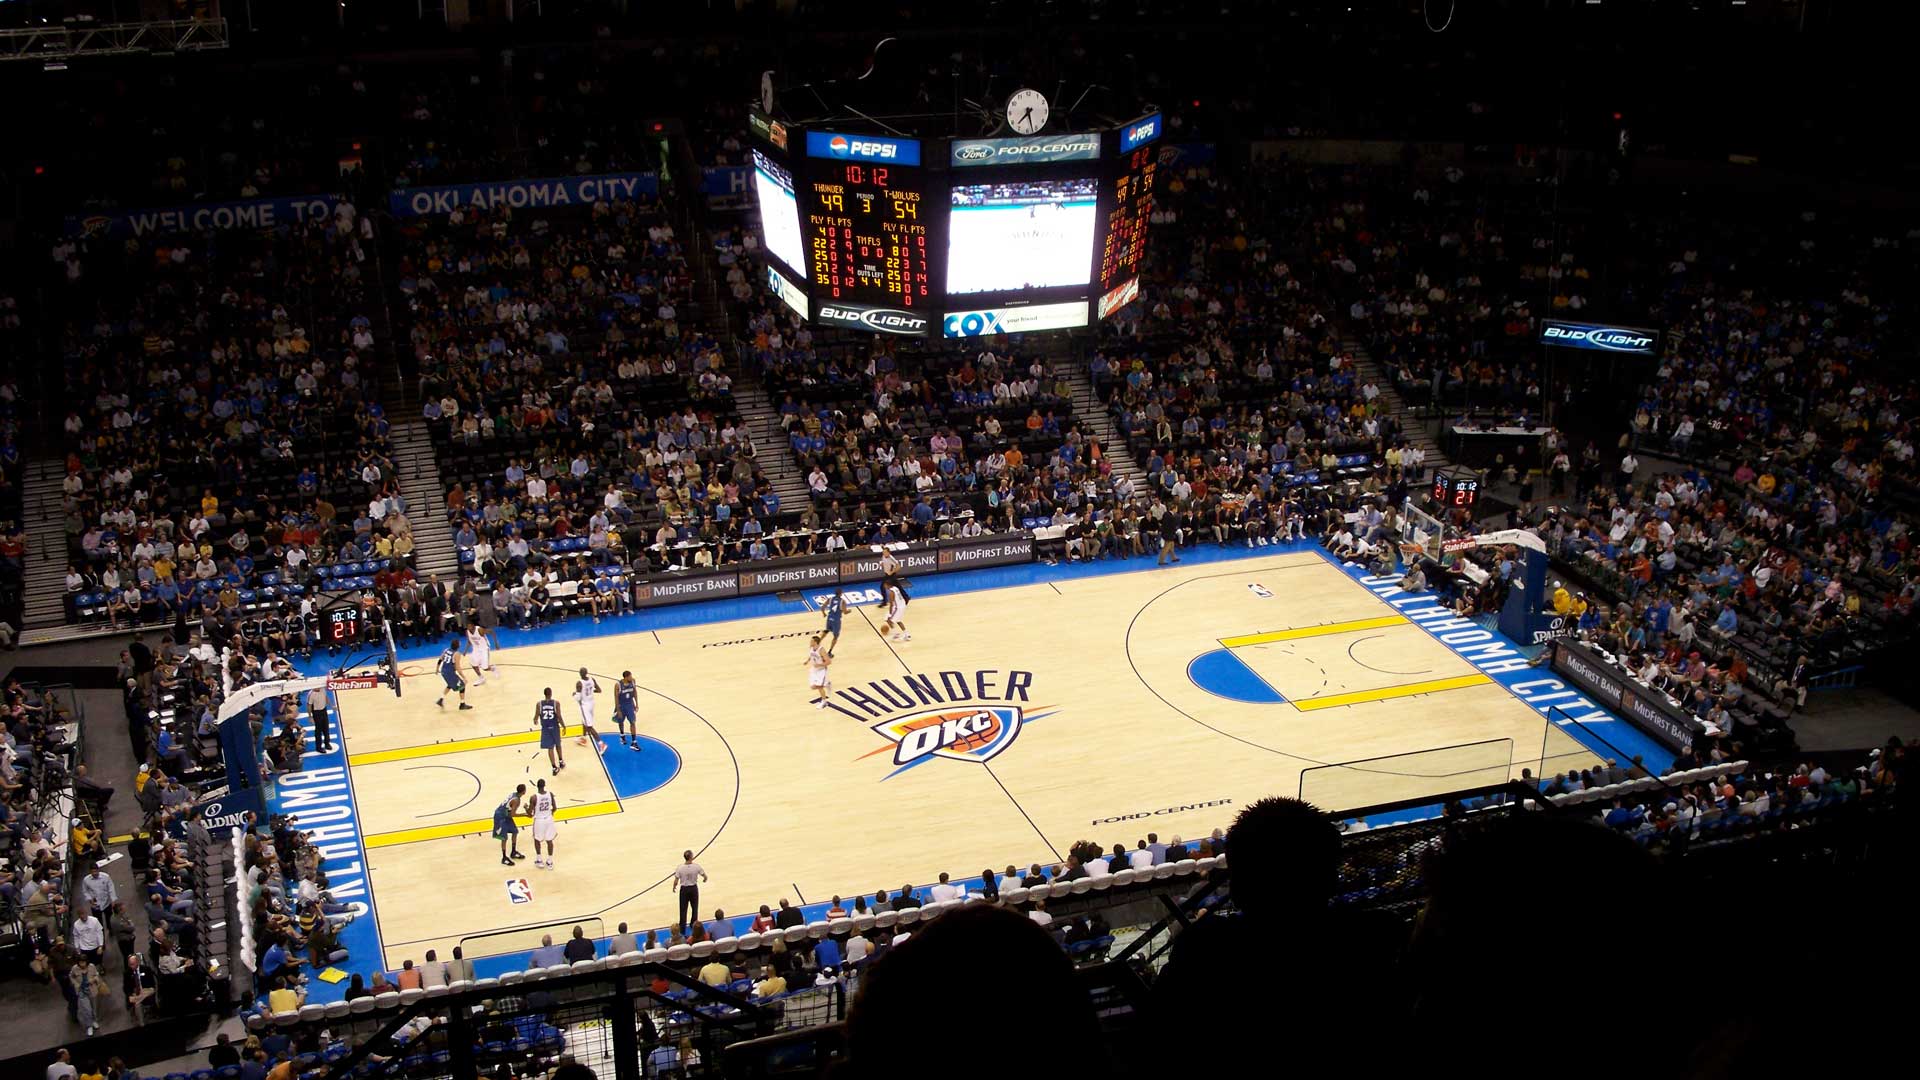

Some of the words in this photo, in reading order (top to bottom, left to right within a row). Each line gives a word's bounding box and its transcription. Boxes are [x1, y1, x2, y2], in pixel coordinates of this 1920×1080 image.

[1136, 122, 1154, 142] PEPSI
[850, 141, 897, 158] PEPSI
[962, 149, 987, 159] Ford
[998, 144, 1041, 156] FORD
[1042, 143, 1098, 153] CENTER
[846, 166, 888, 186] 10:12
[814, 184, 844, 194] THUNDER
[1144, 174, 1153, 192] 54
[411, 183, 571, 214] OKLAHOMA
[578, 177, 638, 202] CITY
[884, 190, 920, 201] T-WOLVES
[1118, 186, 1127, 204] 49
[822, 194, 842, 212] 49
[863, 199, 870, 212] 3
[895, 201, 916, 219] 54
[128, 203, 275, 236] WELCOME
[290, 200, 330, 223] TO
[811, 215, 823, 224] PLY
[827, 217, 836, 225] FL
[838, 218, 852, 227] PTS
[819, 227, 826, 236] 4
[829, 227, 835, 237] 0
[845, 229, 851, 238] 0
[883, 223, 896, 231] PLY
[900, 225, 909, 233] FL
[911, 225, 925, 234] PTS
[814, 238, 826, 248] 22
[830, 240, 836, 249] 2
[846, 241, 852, 250] 9
[867, 237, 881, 246] FLS
[892, 234, 898, 243] 4
[918, 237, 924, 246] 0
[815, 250, 827, 260] 25
[831, 252, 837, 261] 0
[846, 254, 853, 262] 4
[862, 247, 868, 256] 0
[877, 248, 883, 258] 0
[893, 246, 899, 256] 8
[903, 247, 909, 257] 0
[920, 249, 925, 258] 7
[816, 262, 828, 272] 27
[832, 264, 837, 273] 2
[848, 266, 854, 274] 4
[887, 258, 899, 268] 22
[904, 260, 909, 269] 3
[920, 261, 926, 270] 7
[817, 274, 829, 284] 35
[833, 276, 838, 285] 0
[845, 277, 854, 286] 12
[862, 277, 868, 286] 4
[874, 278, 881, 287] 4
[888, 270, 900, 280] 25
[904, 272, 910, 281] 0
[917, 273, 926, 283] 14
[834, 288, 839, 296] 0
[889, 282, 901, 292] 33
[905, 284, 910, 293] 0
[921, 286, 927, 295] 6
[905, 296, 911, 305] 0
[820, 308, 860, 320] BUD
[869, 314, 926, 328] LIGHT
[944, 312, 1006, 338] COX
[1544, 327, 1586, 340] BUD
[1595, 333, 1652, 346] LIGHT
[1456, 482, 1477, 490] 10:12
[1456, 491, 1473, 504] 21
[955, 548, 1002, 562] MIDFIRST
[1004, 544, 1031, 556] BANK
[908, 556, 936, 566] BANK
[757, 570, 806, 584] MIDFIRST
[809, 566, 838, 578] BANK
[654, 583, 704, 597] MIDFIRST
[707, 578, 736, 590] BANK
[332, 610, 357, 622] 10:12
[334, 620, 354, 638] 21
[702, 638, 754, 648] FORD
[1566, 655, 1600, 684] MIDFIRST
[1601, 680, 1622, 700] BANK
[809, 670, 1032, 722] THUNDER
[1510, 678, 1615, 726] CITY
[543, 710, 554, 720] 25
[1634, 700, 1670, 730] MIDFIRST
[1671, 725, 1693, 747] BANK
[895, 711, 993, 763] OKC
[540, 802, 550, 811] 22
[1092, 812, 1152, 826] FORD
[1154, 799, 1232, 816] CENTER
